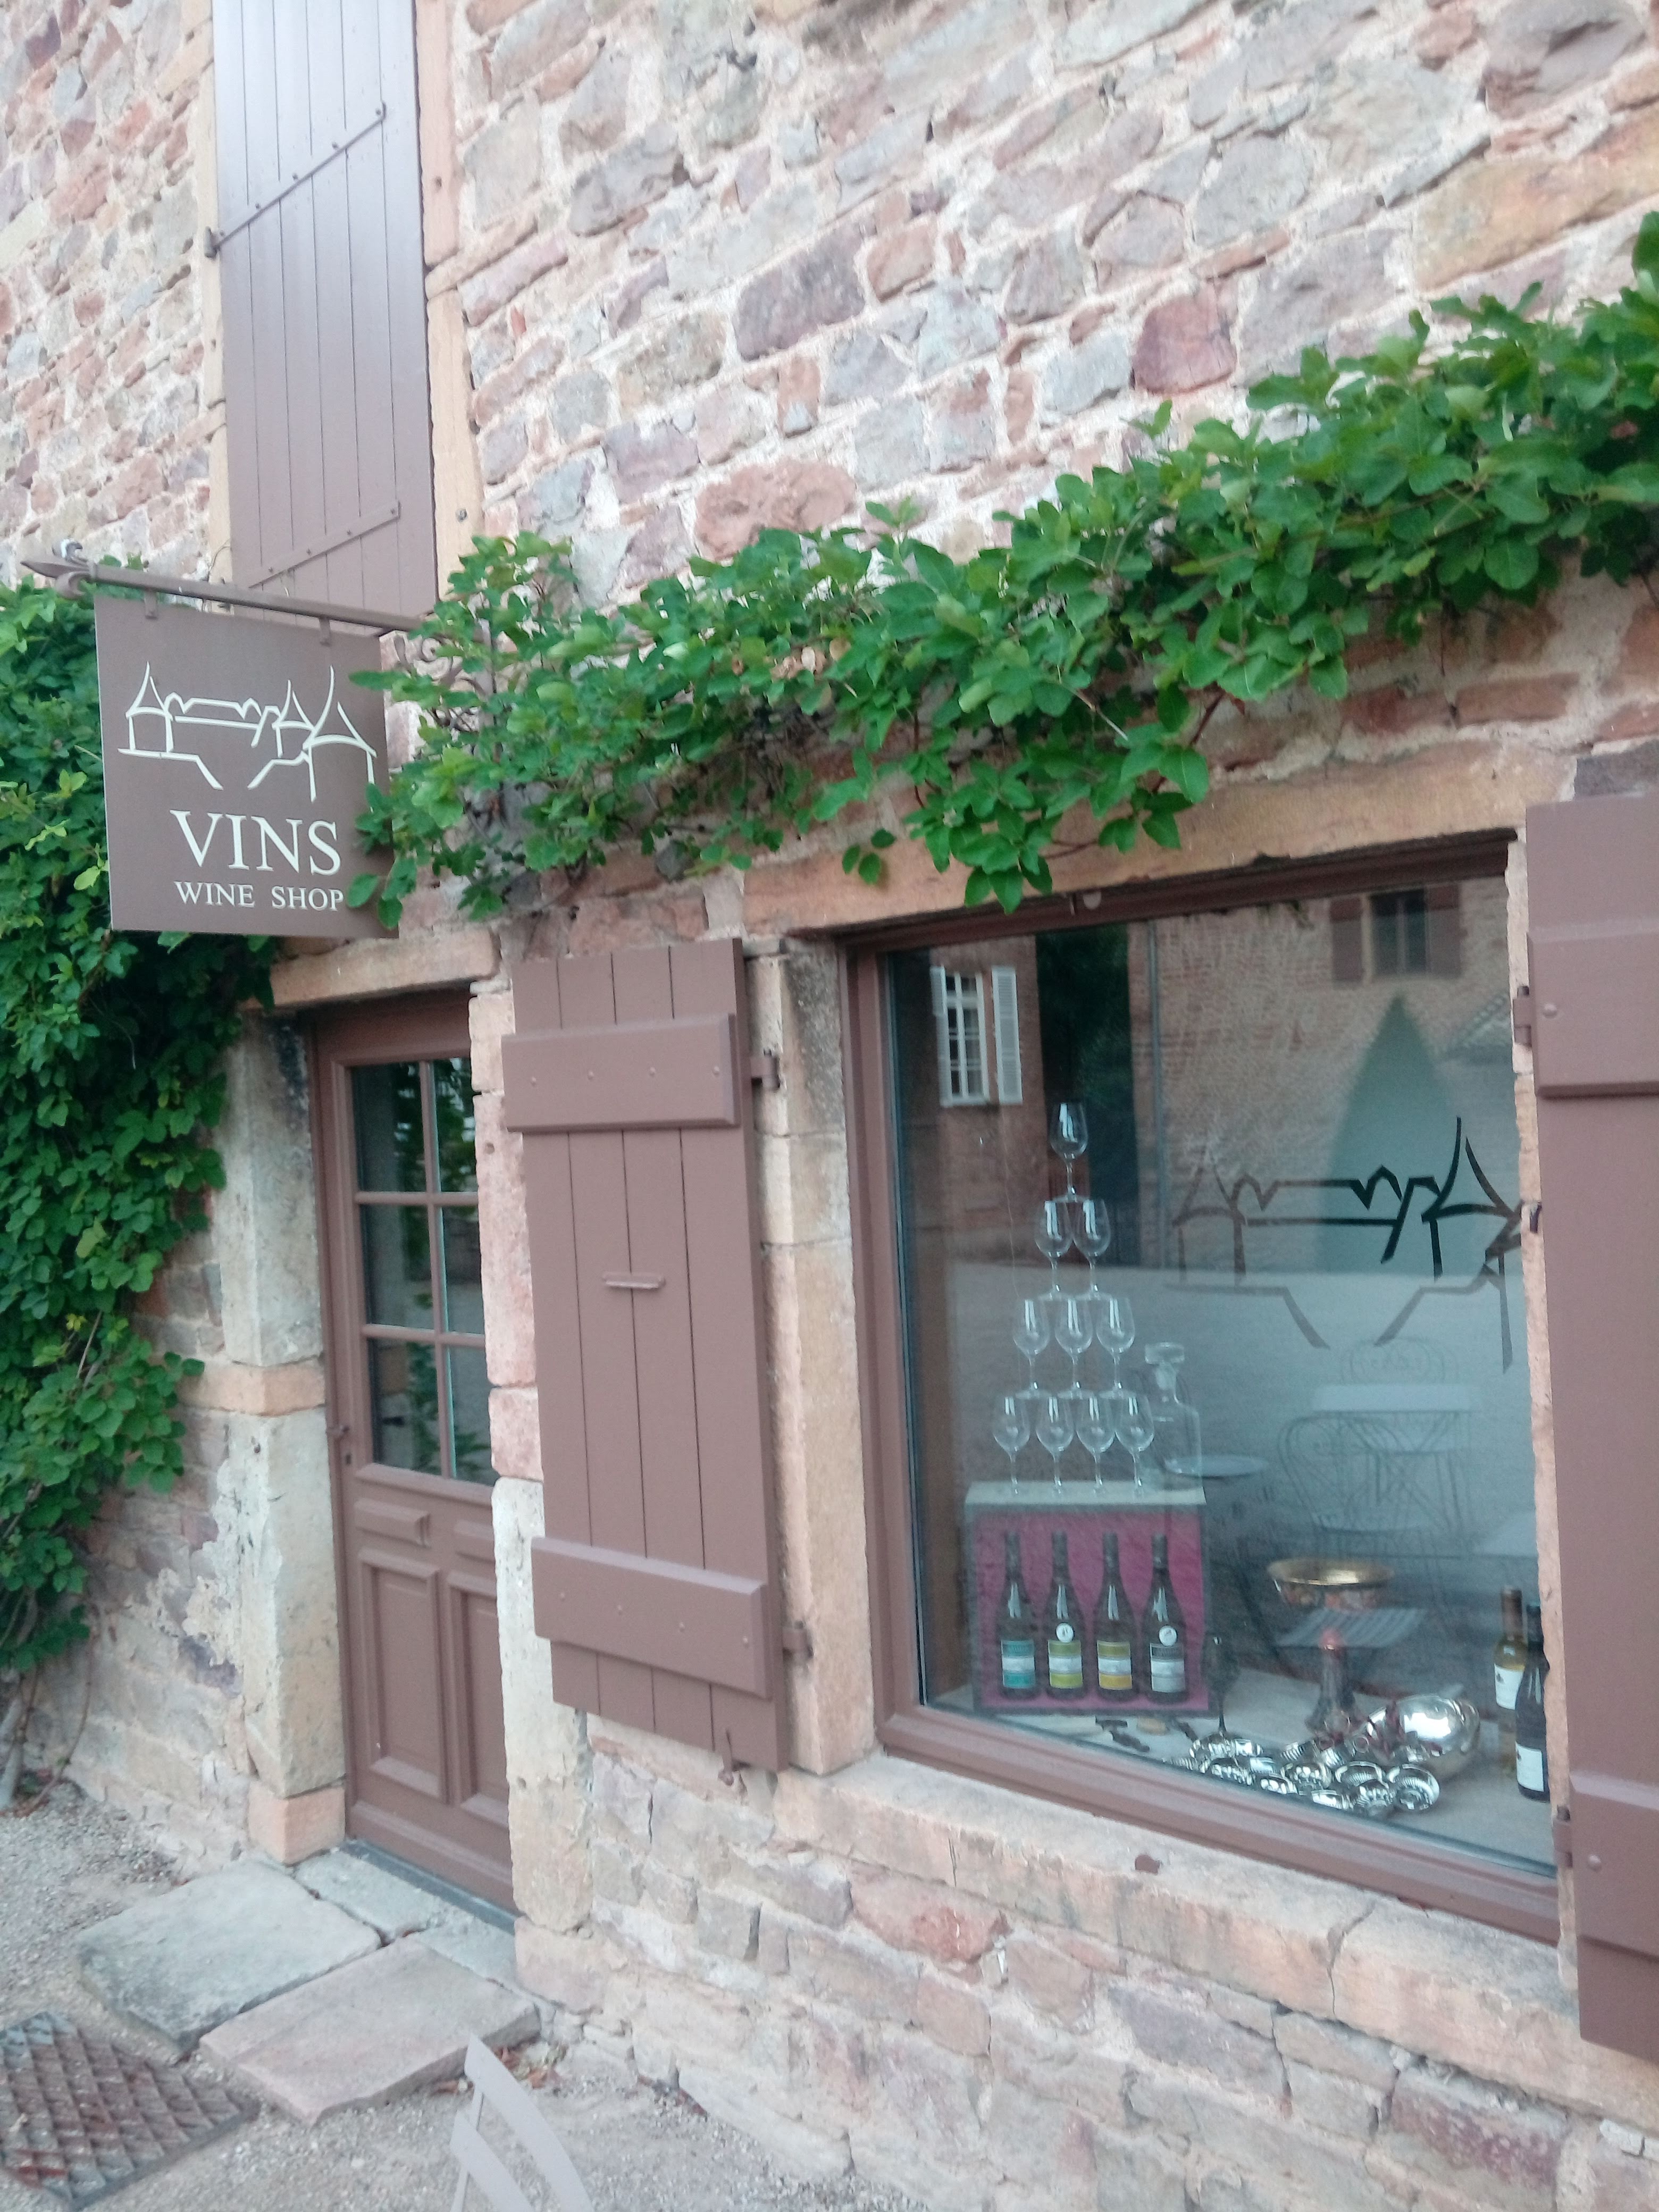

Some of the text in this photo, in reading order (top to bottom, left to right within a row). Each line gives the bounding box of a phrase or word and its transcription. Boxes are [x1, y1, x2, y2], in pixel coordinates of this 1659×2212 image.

[169, 809, 342, 876] VINS
[173, 881, 344, 911] WINE SHOP
